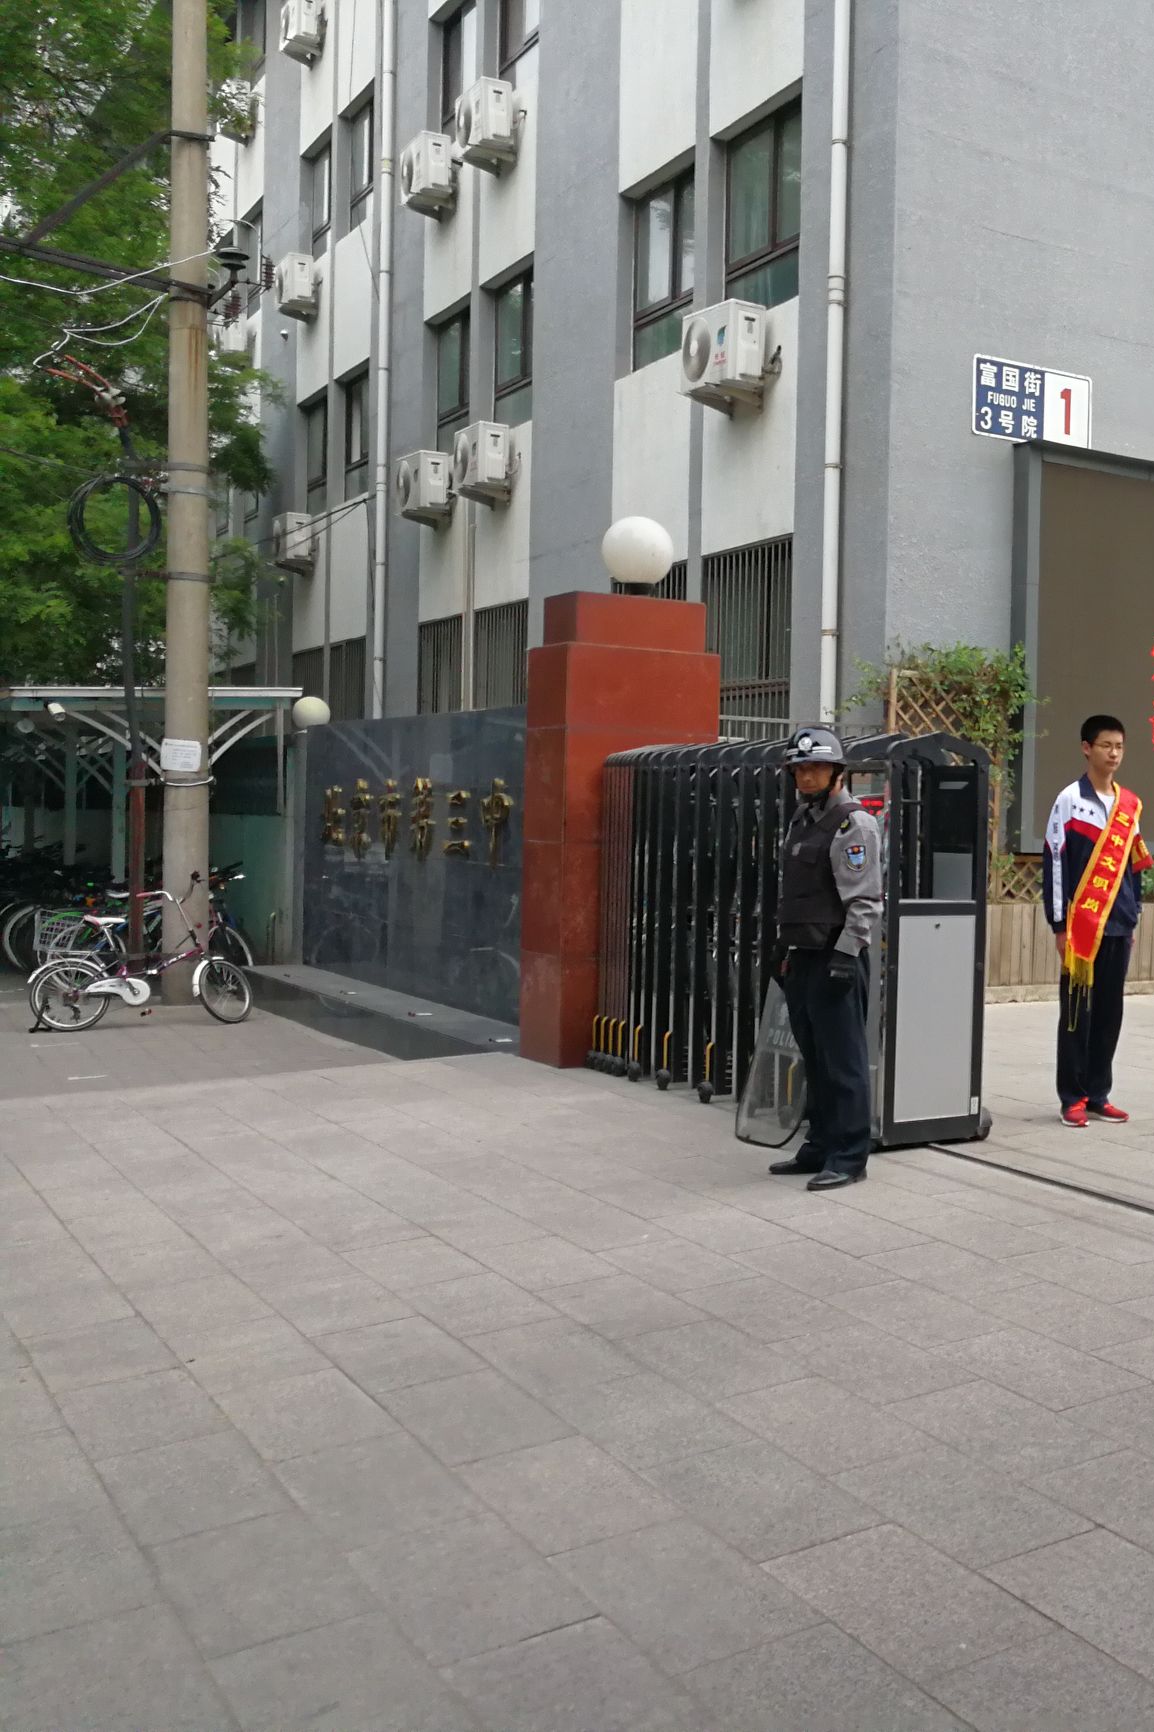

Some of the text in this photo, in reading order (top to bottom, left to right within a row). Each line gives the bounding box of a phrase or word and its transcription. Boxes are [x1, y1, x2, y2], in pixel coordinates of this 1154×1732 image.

[979, 362, 1042, 397] 富国街
[987, 391, 1036, 412] FUGUO JIE
[1060, 387, 1072, 436] 1
[979, 406, 1038, 439] 3号院
[766, 1027, 800, 1050] POLIC
